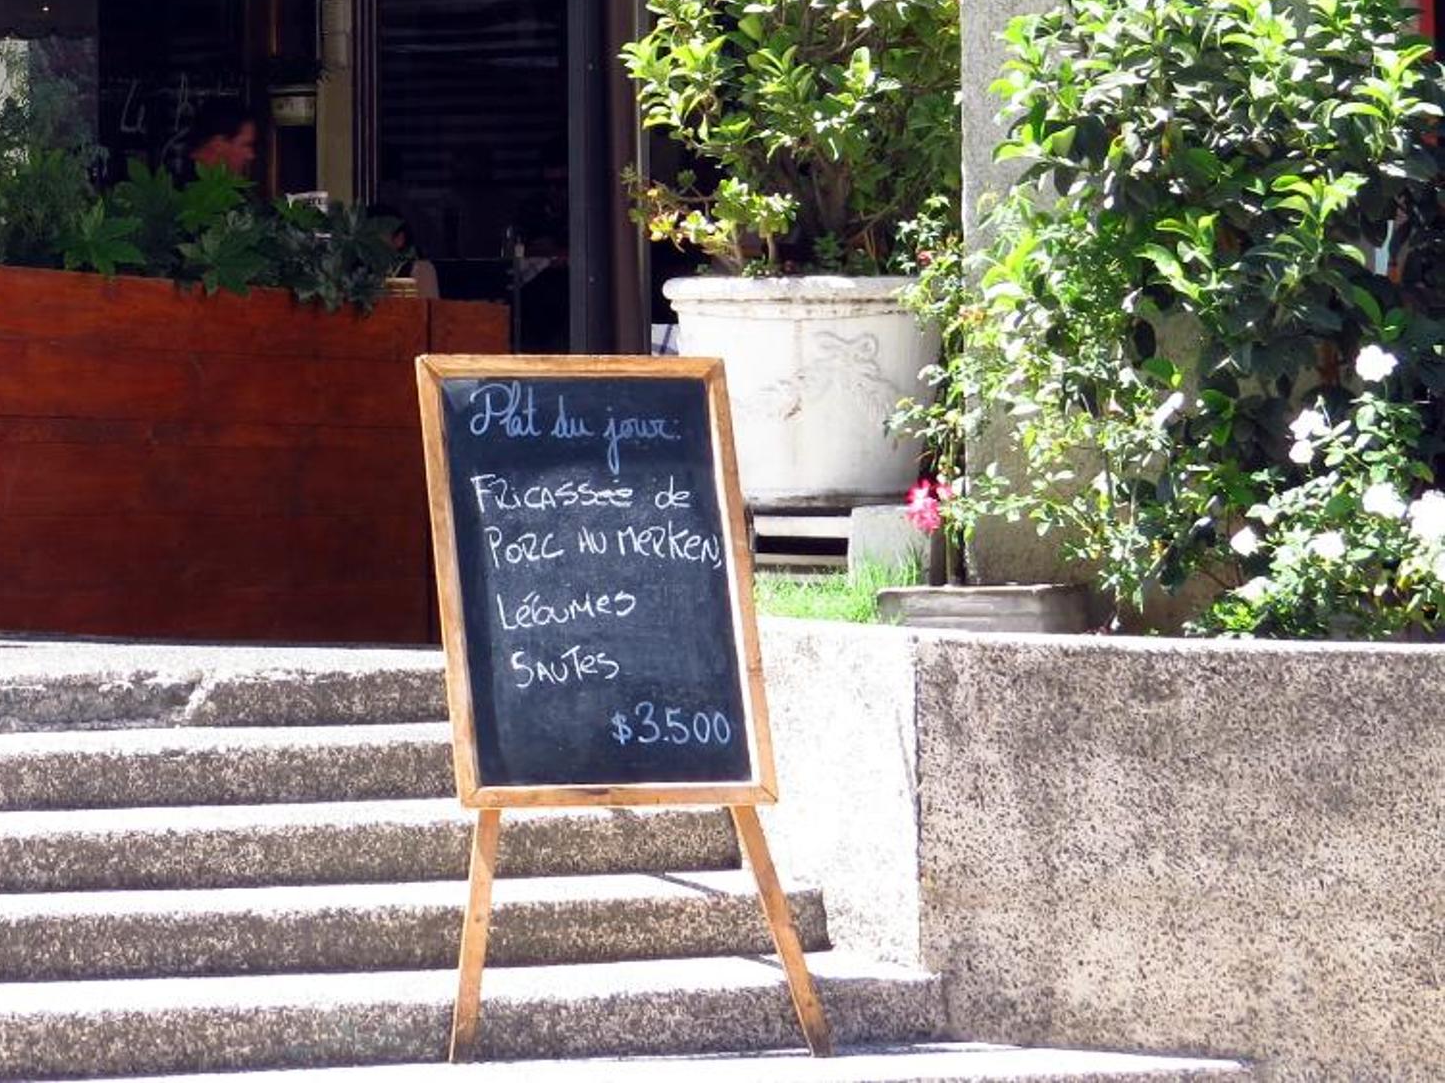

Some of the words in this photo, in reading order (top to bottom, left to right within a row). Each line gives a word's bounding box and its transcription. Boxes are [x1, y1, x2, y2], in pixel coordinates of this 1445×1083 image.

[470, 380, 541, 437] Plat
[551, 395, 594, 438] du
[655, 474, 691, 509] de
[610, 701, 731, 745] $3.500
